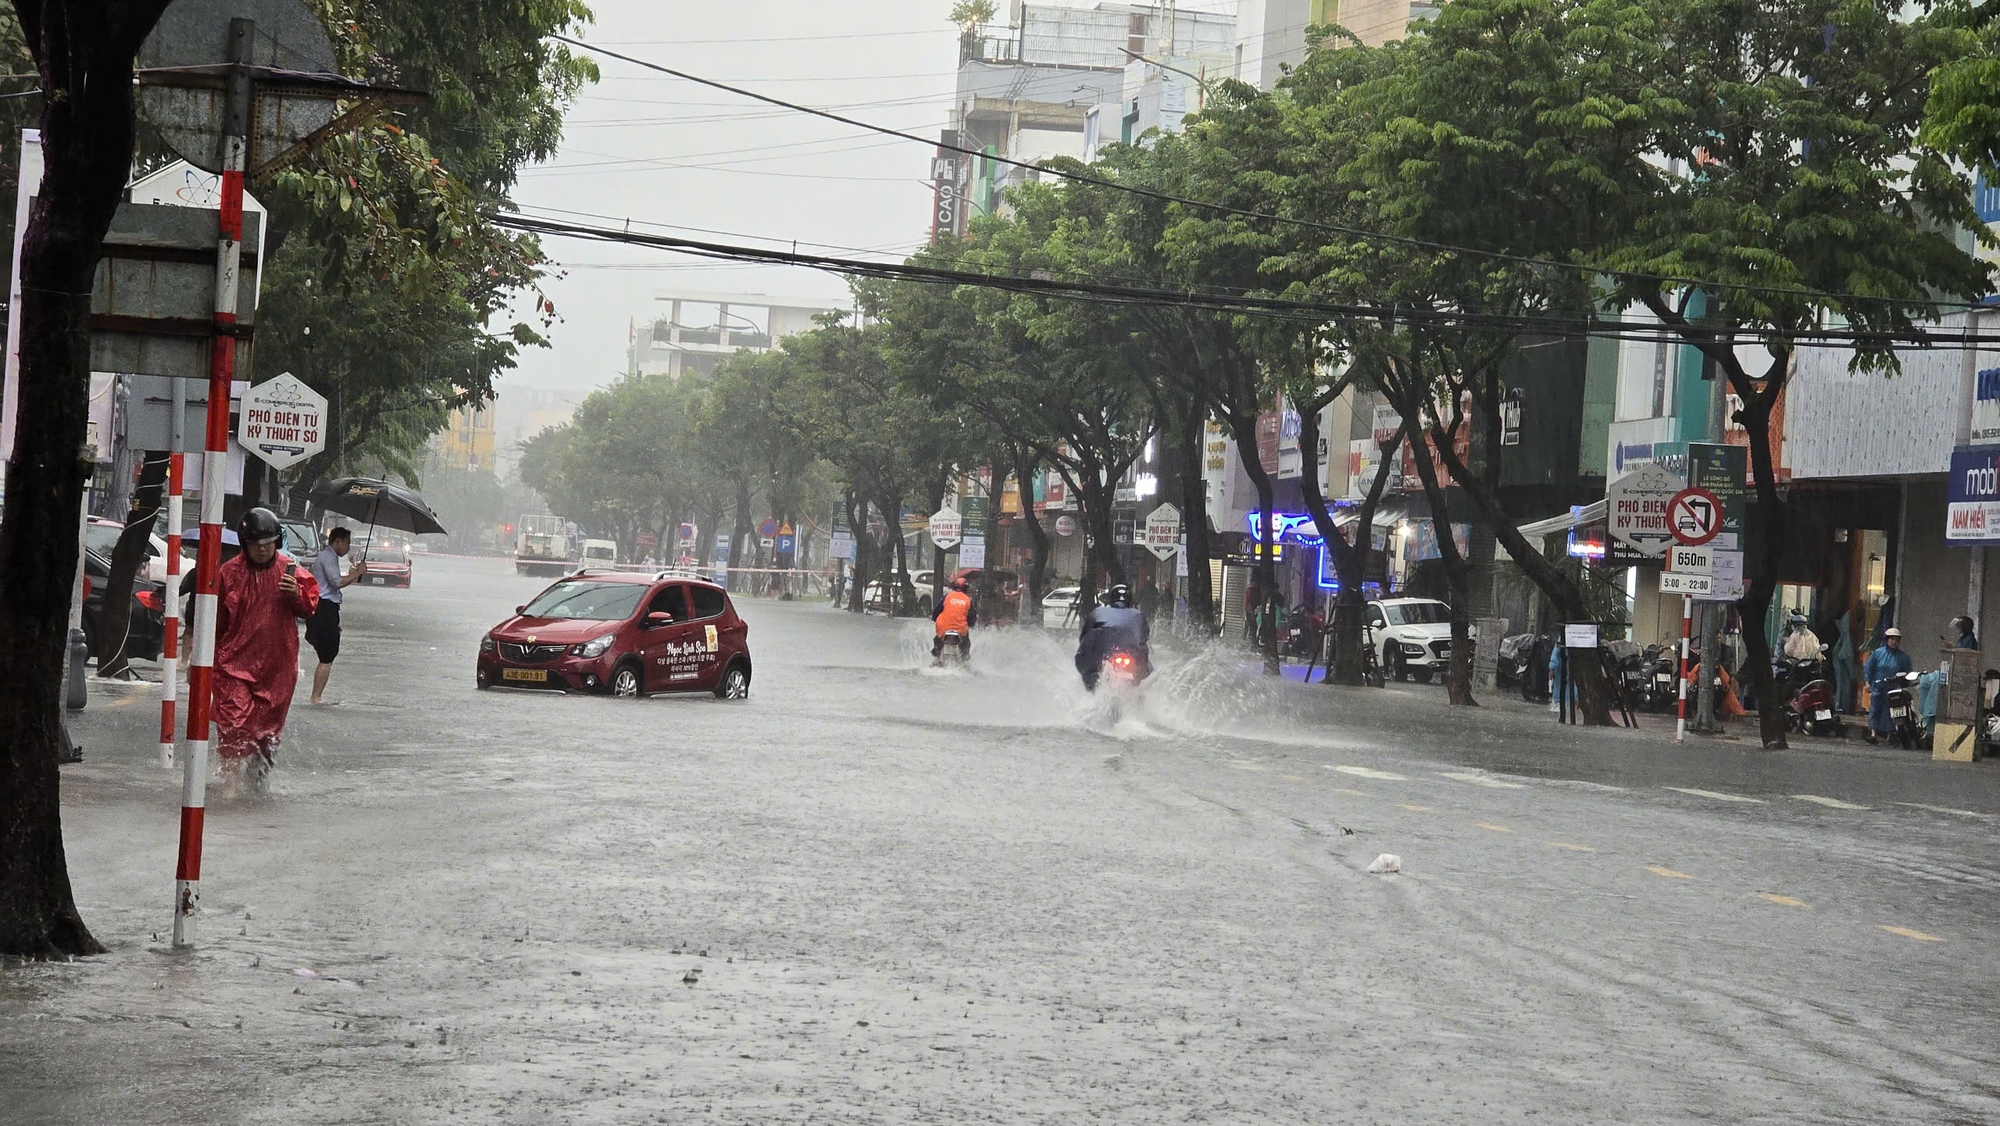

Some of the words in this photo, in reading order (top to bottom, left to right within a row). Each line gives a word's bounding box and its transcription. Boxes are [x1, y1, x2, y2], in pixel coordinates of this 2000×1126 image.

[938, 185, 953, 224] CAO
[248, 408, 271, 424] PHỐ
[274, 411, 300, 427] ĐIỆN
[303, 411, 319, 428] TỬ
[247, 424, 262, 439] KỸ
[265, 426, 301, 443] THUẬT
[303, 428, 318, 443] SỐ
[1618, 498, 1639, 513] PHỐ
[1642, 500, 1667, 516] ĐIỆN
[782, 540, 791, 549] P
[1643, 552, 1666, 560] LTOP
[1677, 552, 1706, 568] 650m
[1664, 578, 1680, 589] 5:00
[1688, 579, 1709, 590] 22:00
[695, 640, 706, 655] Spa
